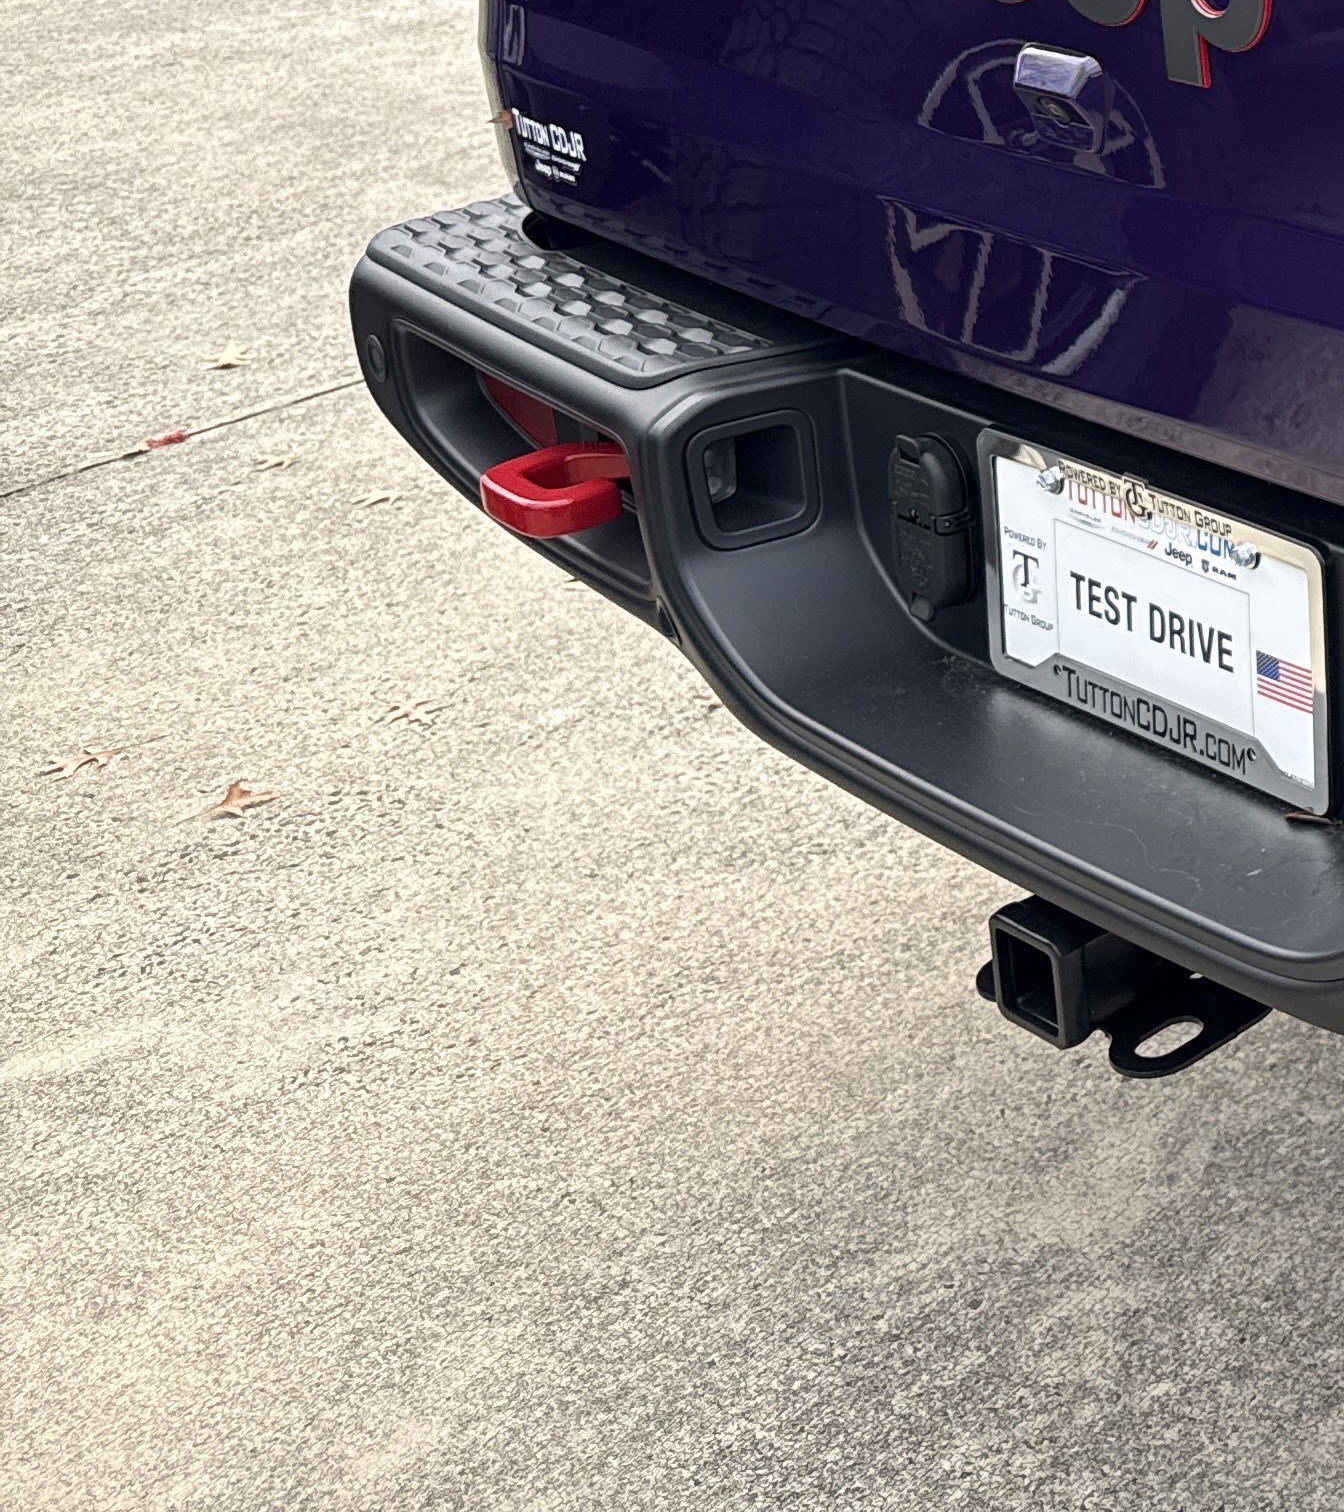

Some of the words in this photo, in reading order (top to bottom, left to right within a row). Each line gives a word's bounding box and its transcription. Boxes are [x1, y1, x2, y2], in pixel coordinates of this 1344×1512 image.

[511, 107, 550, 147] TUTTON
[549, 123, 587, 162] CDJR
[1058, 460, 1106, 491] POWERED
[1108, 479, 1121, 495] BY
[1148, 492, 1192, 523] TUTTON
[1193, 510, 1232, 536] GROUP
[1164, 541, 1193, 567] Jeep
[1211, 566, 1237, 581] RAM
[1069, 570, 1138, 633] TEST
[1148, 602, 1235, 674] DRIVE
[1061, 665, 1247, 776] TUTTONCDJR.COM
